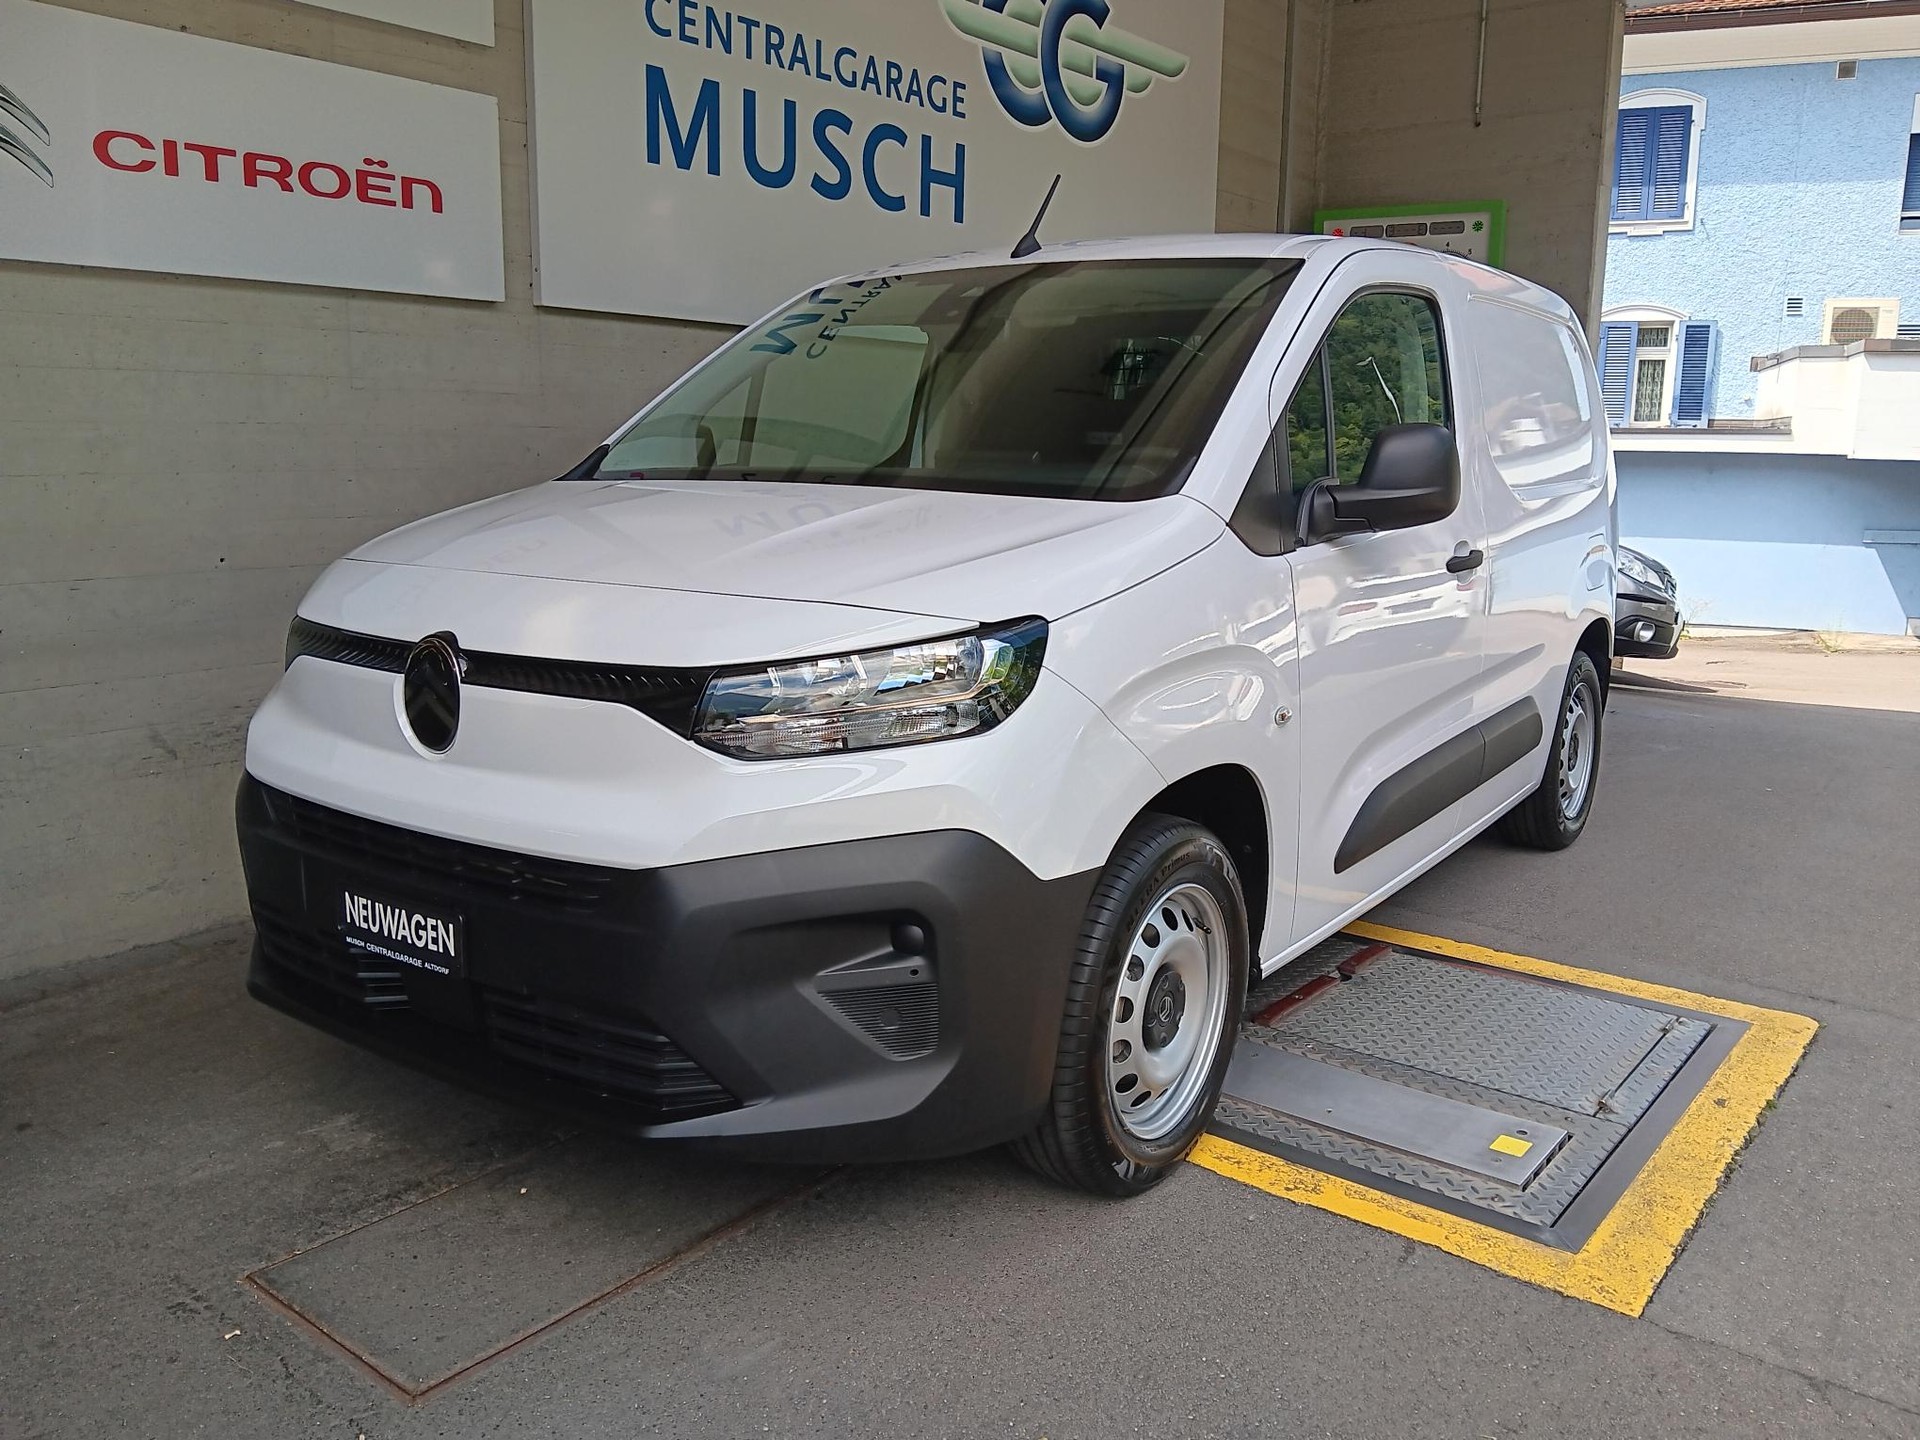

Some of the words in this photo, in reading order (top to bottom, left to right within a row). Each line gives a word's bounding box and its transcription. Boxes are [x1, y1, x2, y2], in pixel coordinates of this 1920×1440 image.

[645, 0, 967, 120] CENTRALGARAGE
[645, 64, 966, 224] MUSCH
[344, 891, 455, 957] NEUWAGEN
[345, 936, 365, 948] MUSCH
[366, 942, 423, 968] CENTRALGARAGE
[424, 961, 450, 976] ALTDORF
